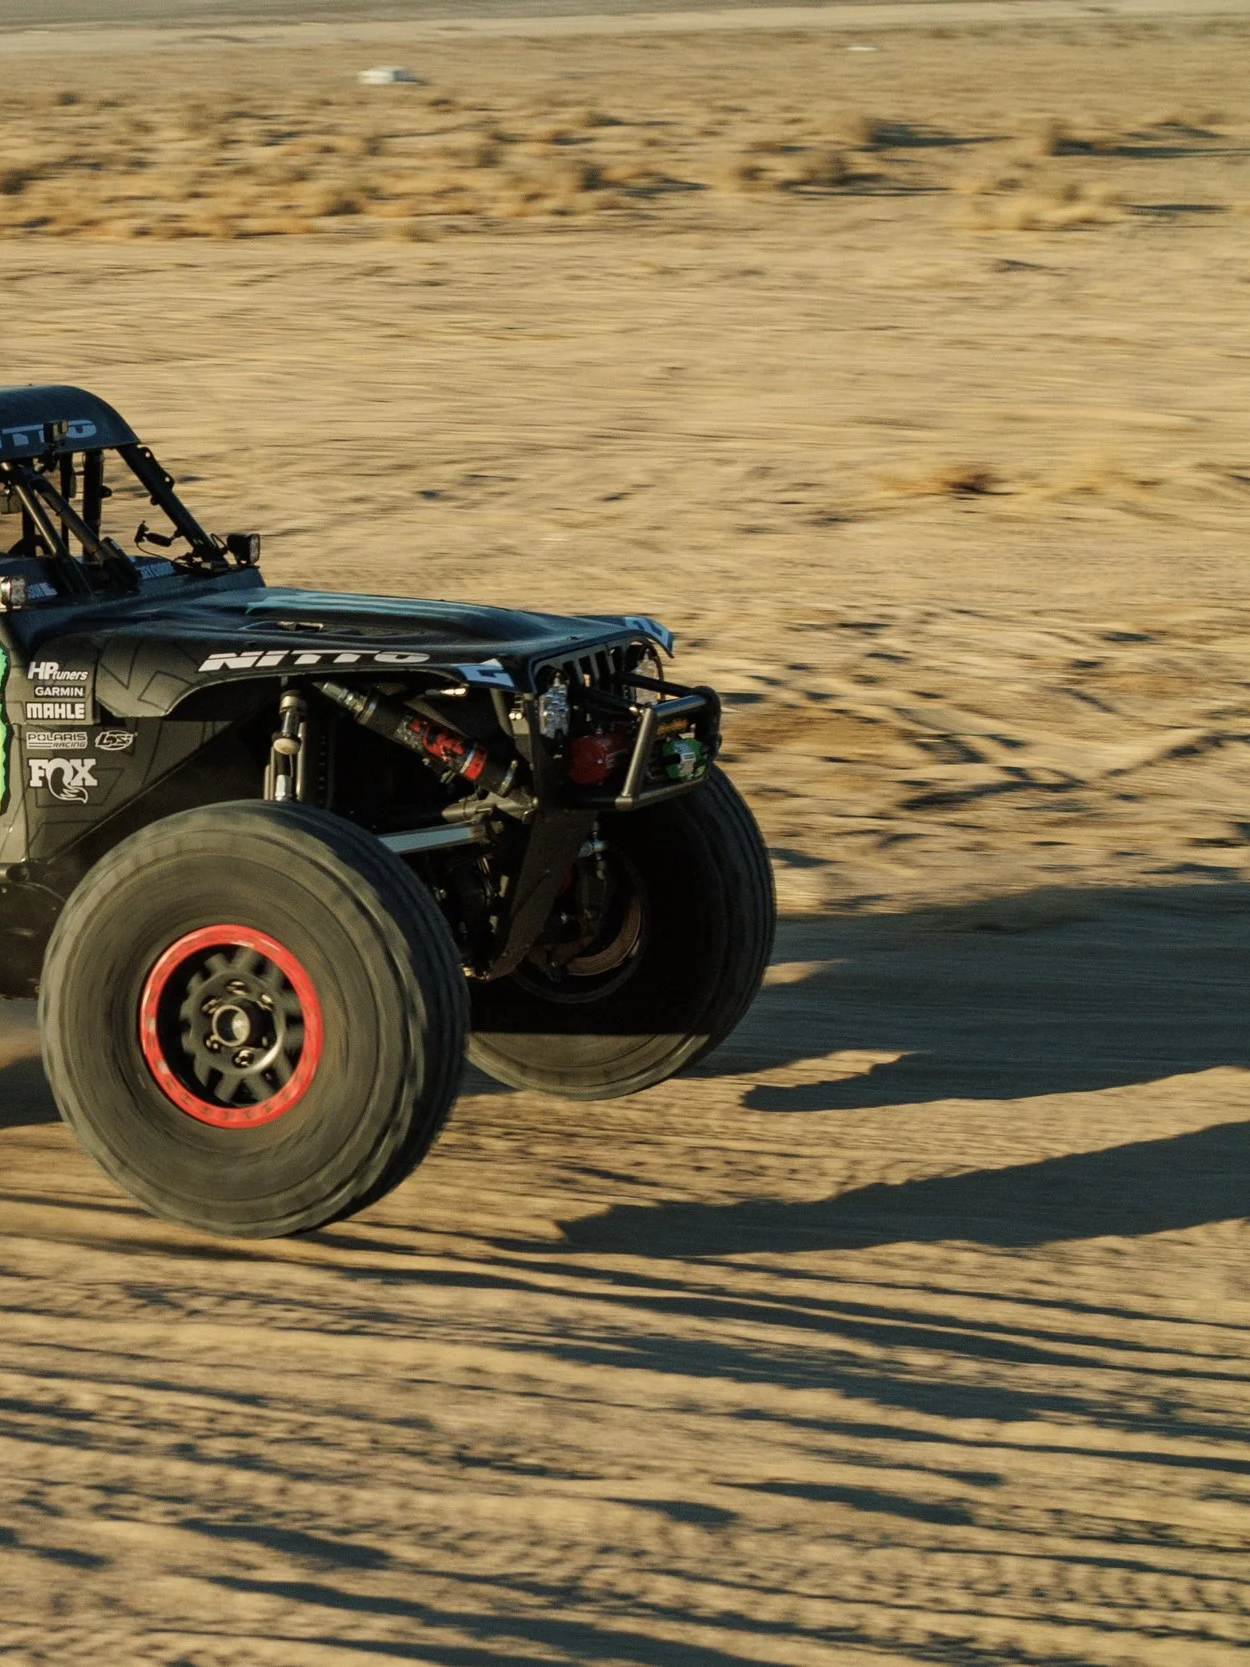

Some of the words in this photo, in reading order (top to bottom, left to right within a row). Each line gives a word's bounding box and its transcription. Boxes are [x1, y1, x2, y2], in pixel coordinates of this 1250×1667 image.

[198, 650, 430, 672] NITTO
[28, 661, 88, 681] HPtuners
[35, 686, 83, 697] GARMIN
[26, 703, 85, 719] MAHLE
[28, 733, 86, 742] POLARIS
[29, 758, 98, 803] FOX
